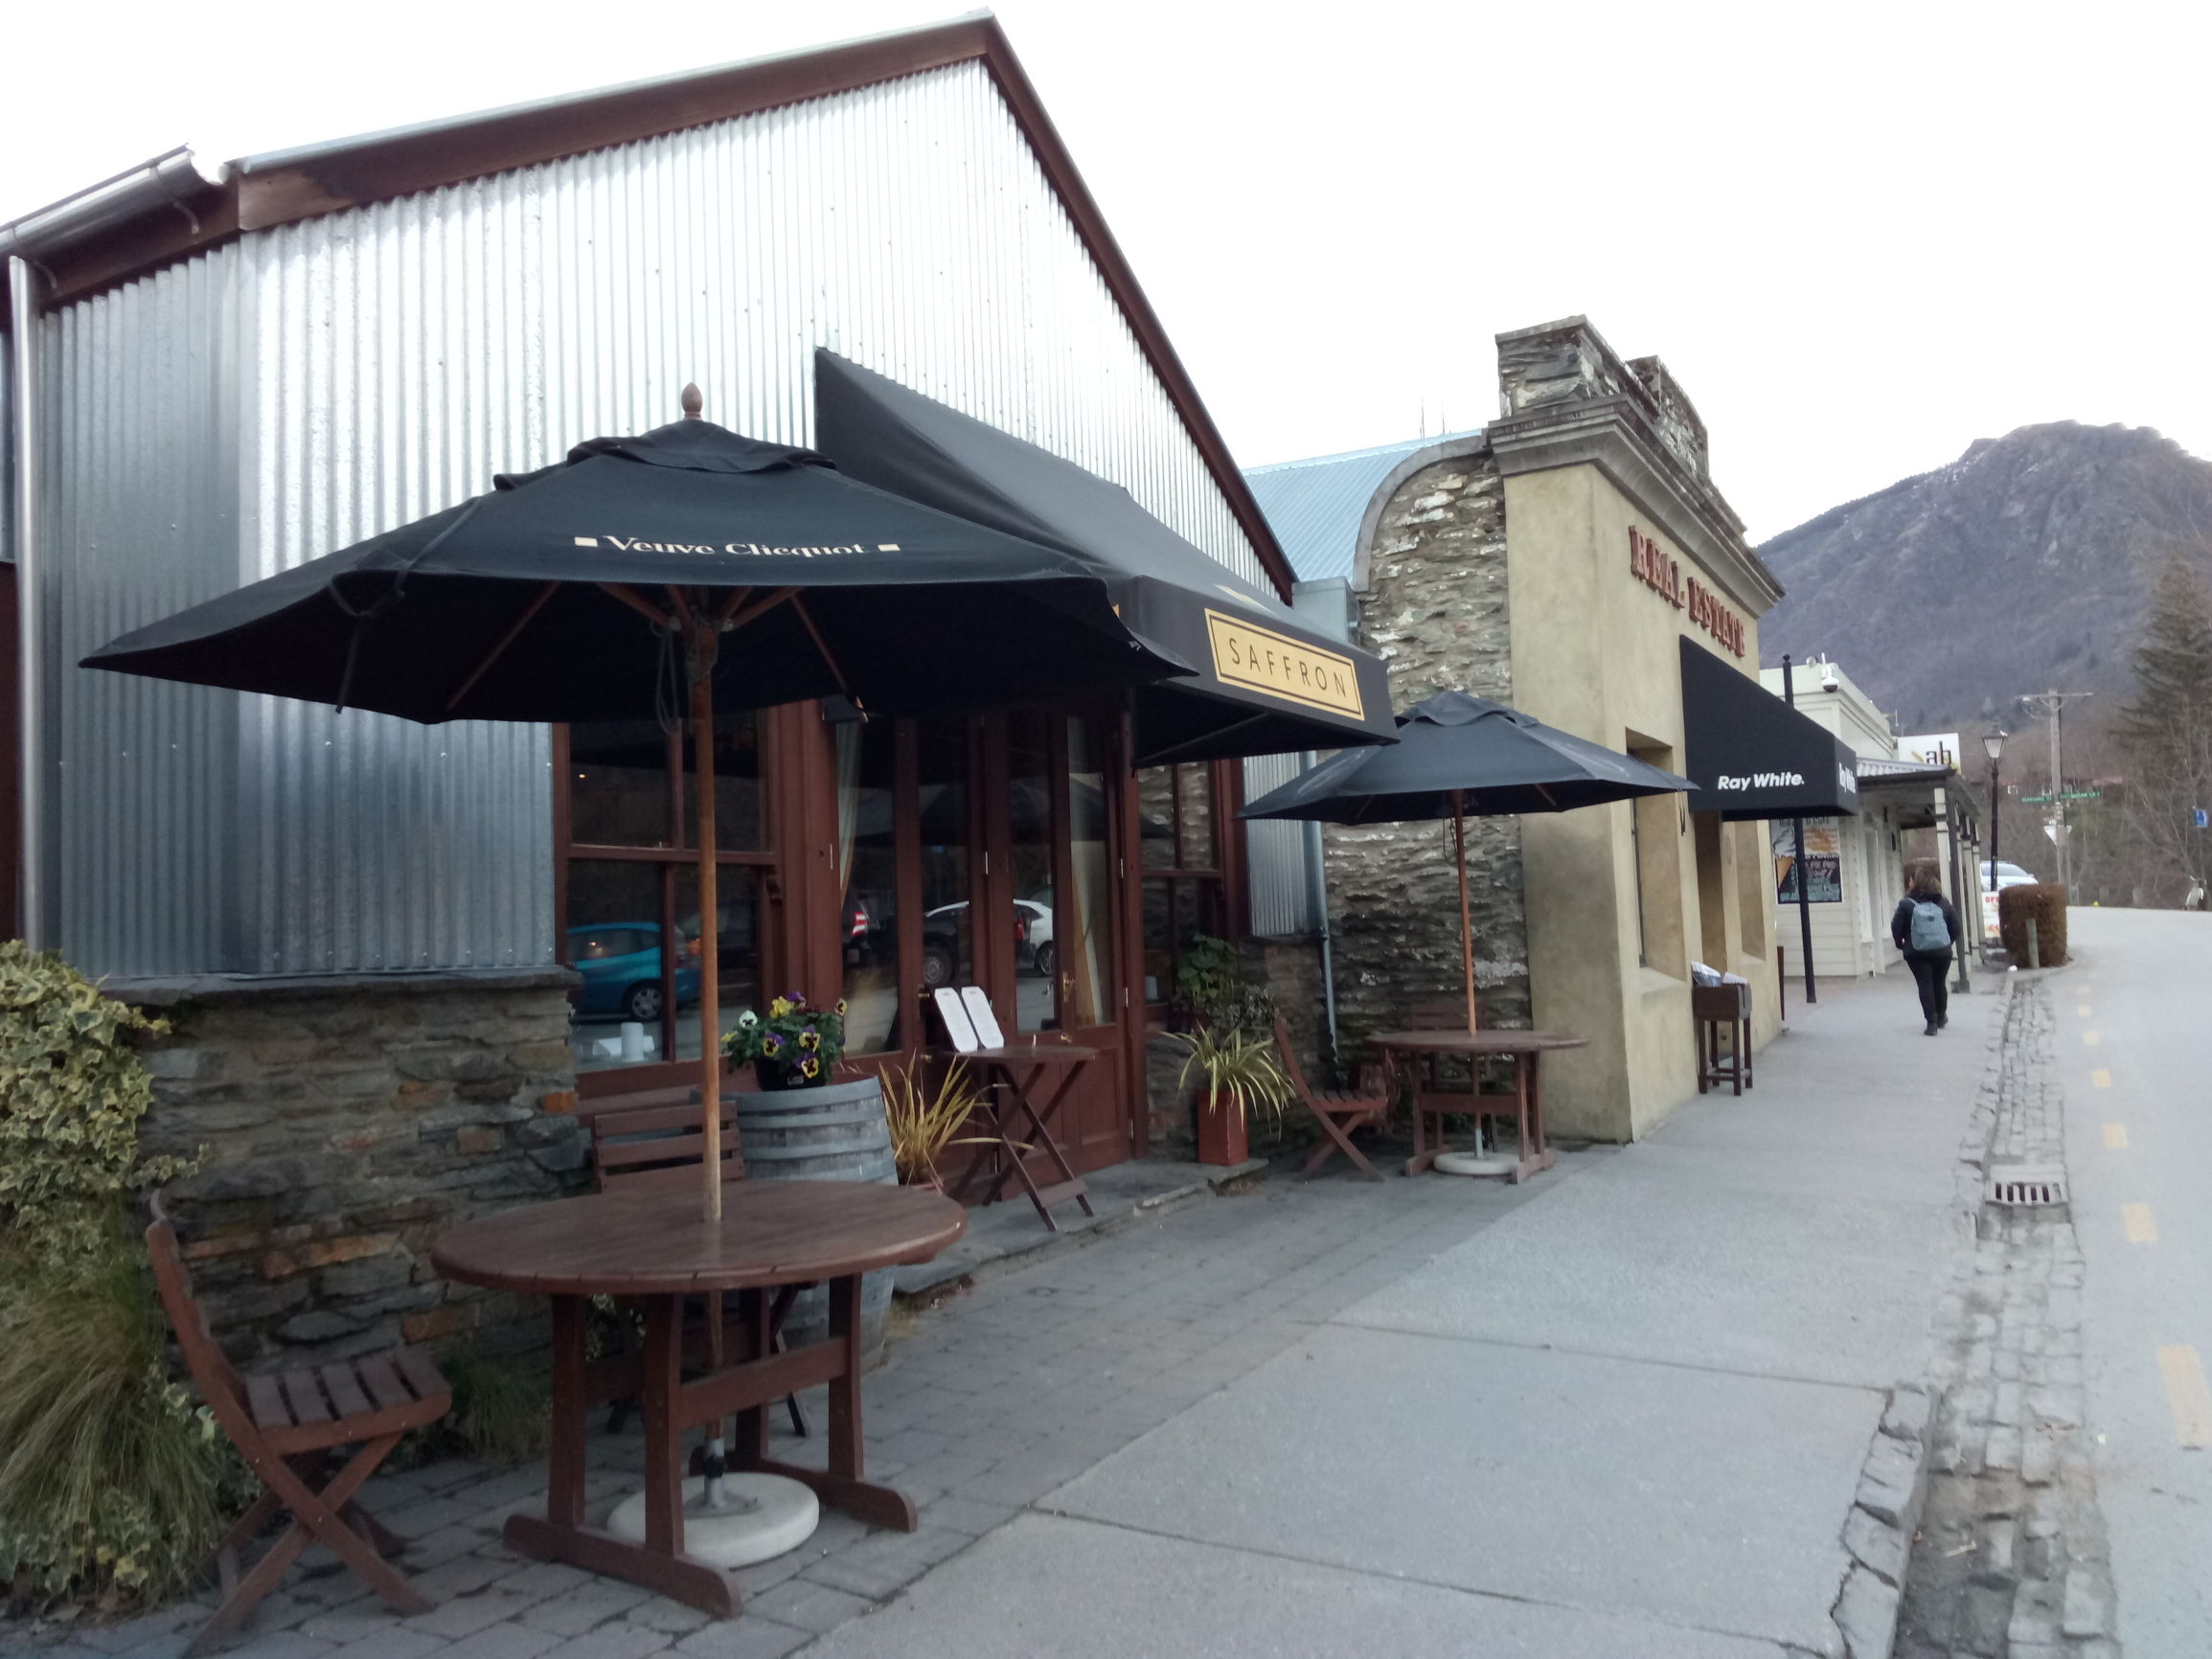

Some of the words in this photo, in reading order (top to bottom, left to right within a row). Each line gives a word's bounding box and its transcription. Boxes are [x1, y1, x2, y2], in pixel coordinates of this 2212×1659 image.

[602, 535, 716, 555] Veuve
[725, 543, 865, 557] Clicquot
[1629, 525, 1685, 609] REAL
[1687, 577, 1745, 659] ESTATE
[1228, 637, 1347, 698] SAFFRON
[1718, 775, 1751, 791] Ray
